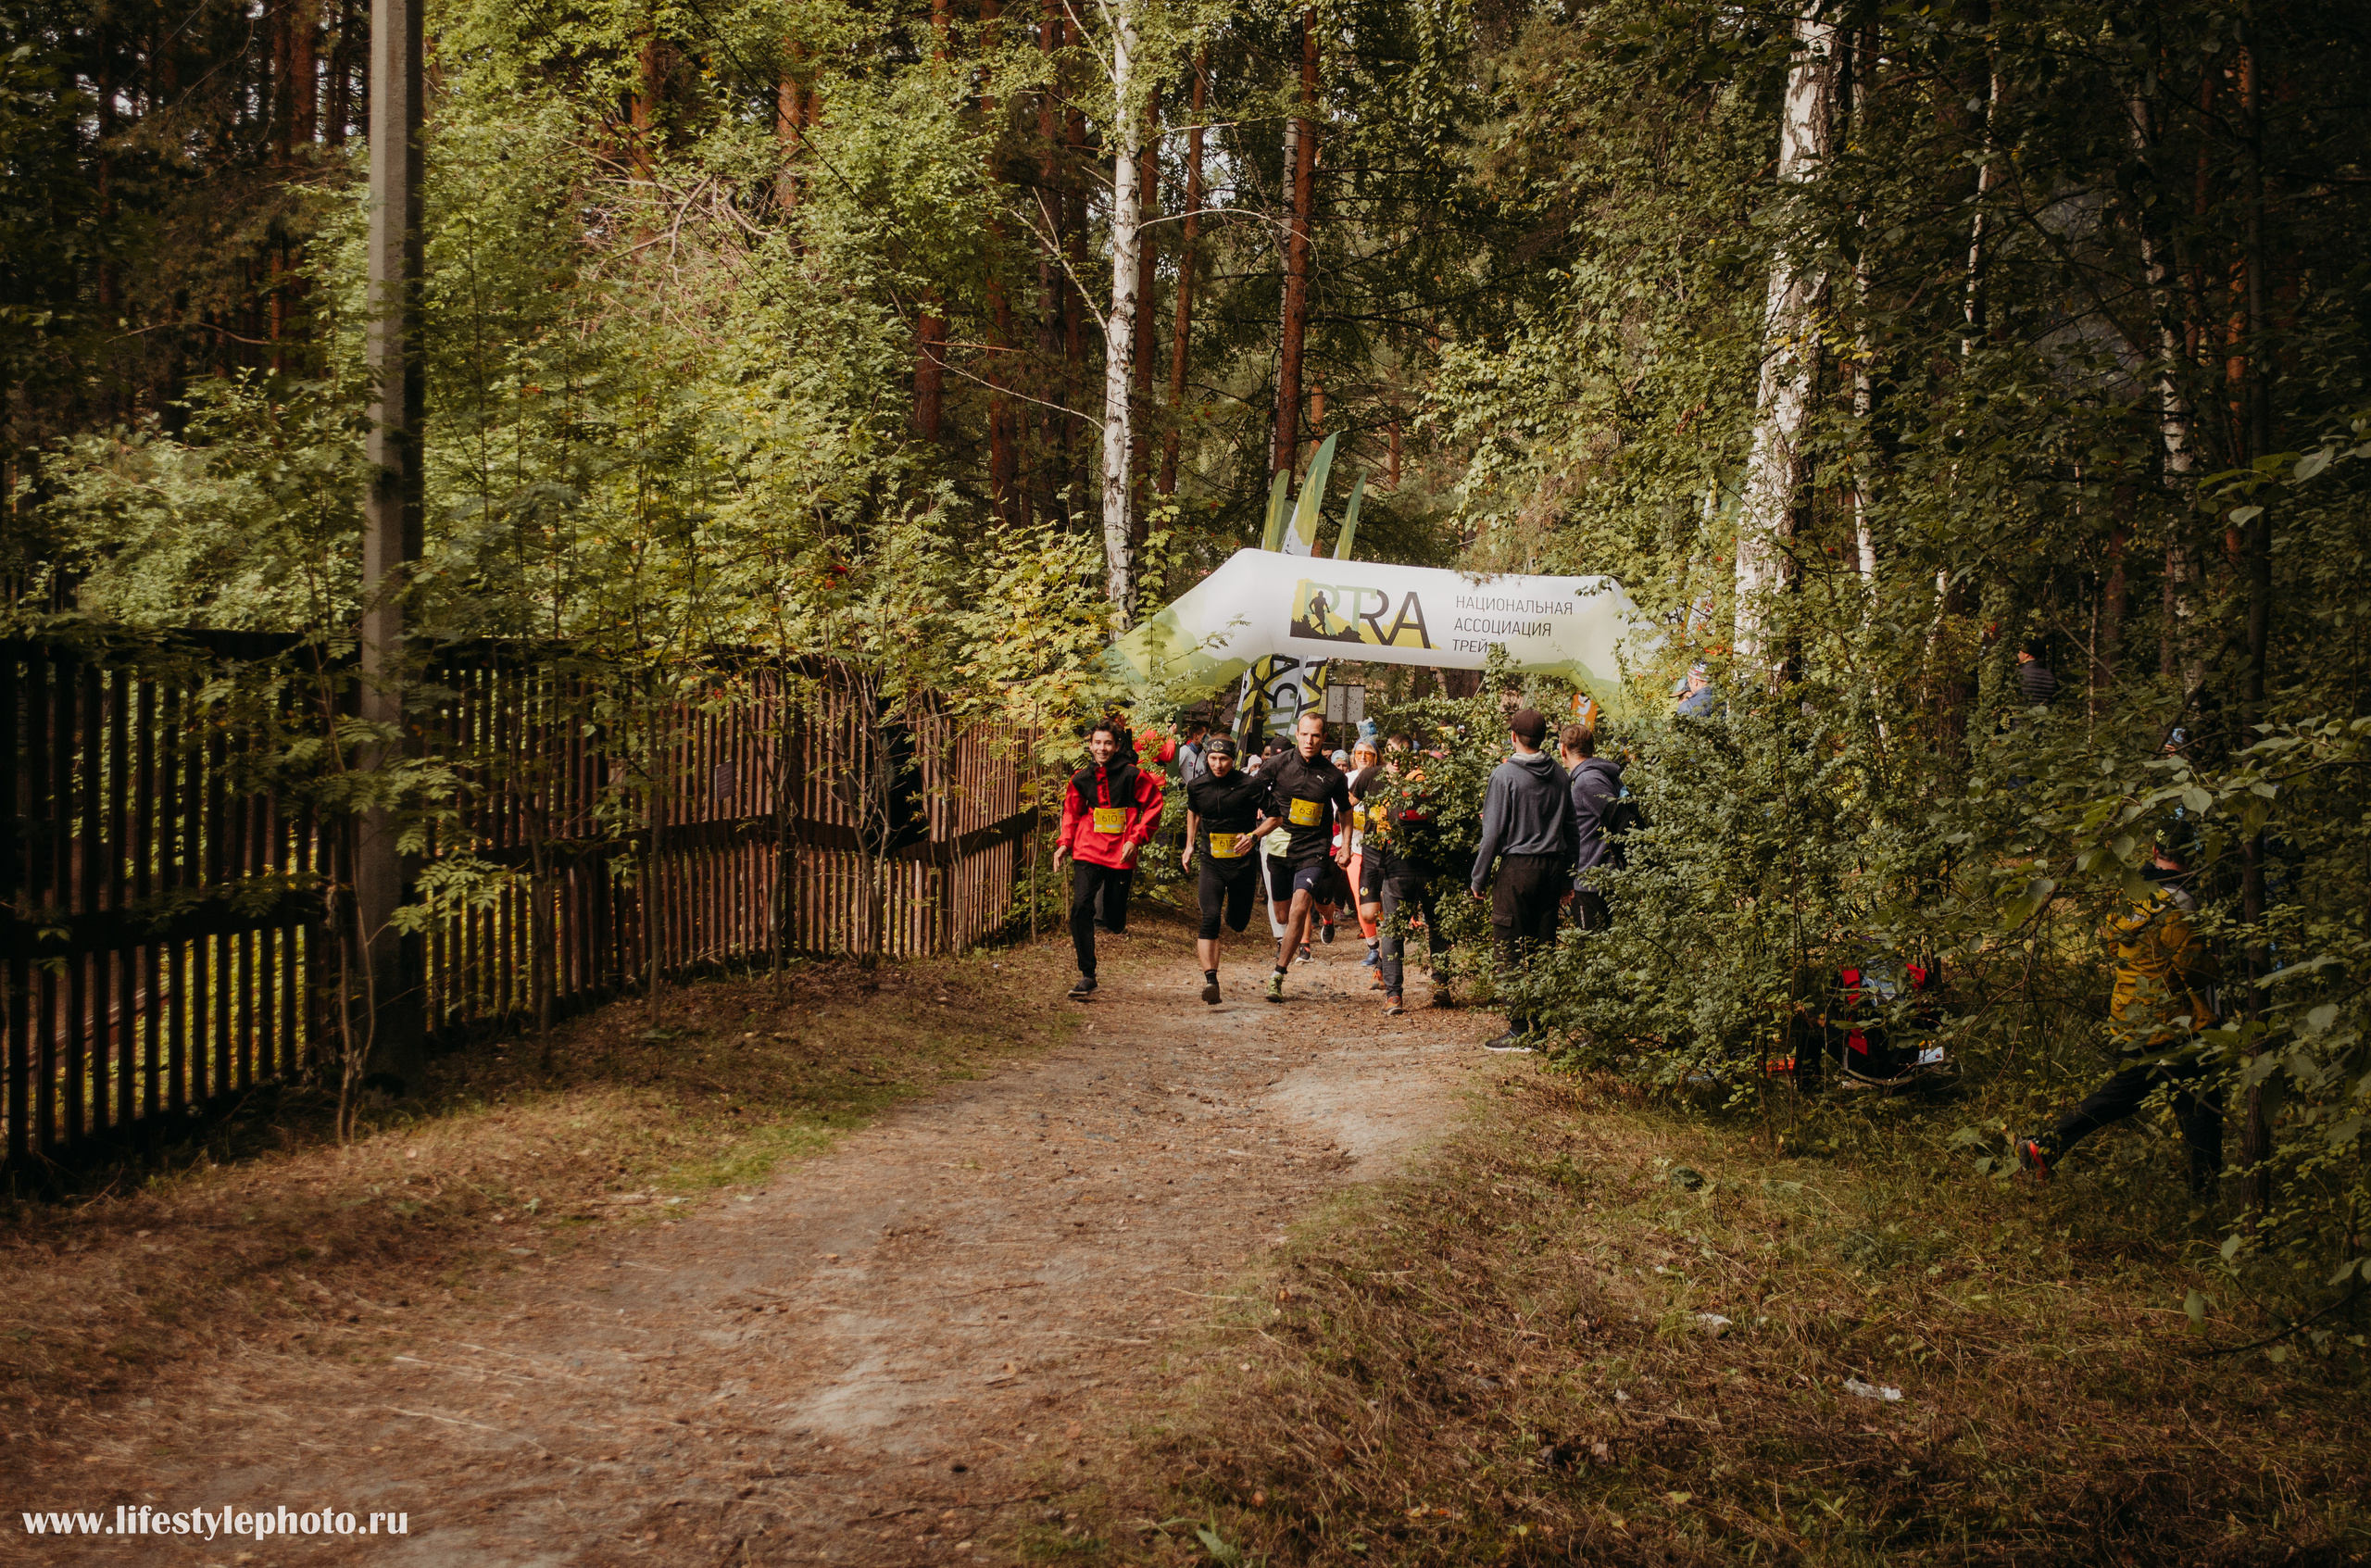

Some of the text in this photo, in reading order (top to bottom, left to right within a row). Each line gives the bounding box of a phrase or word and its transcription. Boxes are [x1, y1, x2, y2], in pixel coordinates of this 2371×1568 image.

[1456, 596, 1573, 615] НАЦИОНАЛЬНАЯ
[1453, 618, 1551, 638] АССОЦИАЦИЯ
[1452, 638, 1507, 654] ТРЕЙ
[1298, 806, 1316, 816] 631
[1101, 814, 1118, 823] 610
[1219, 839, 1236, 848] 612
